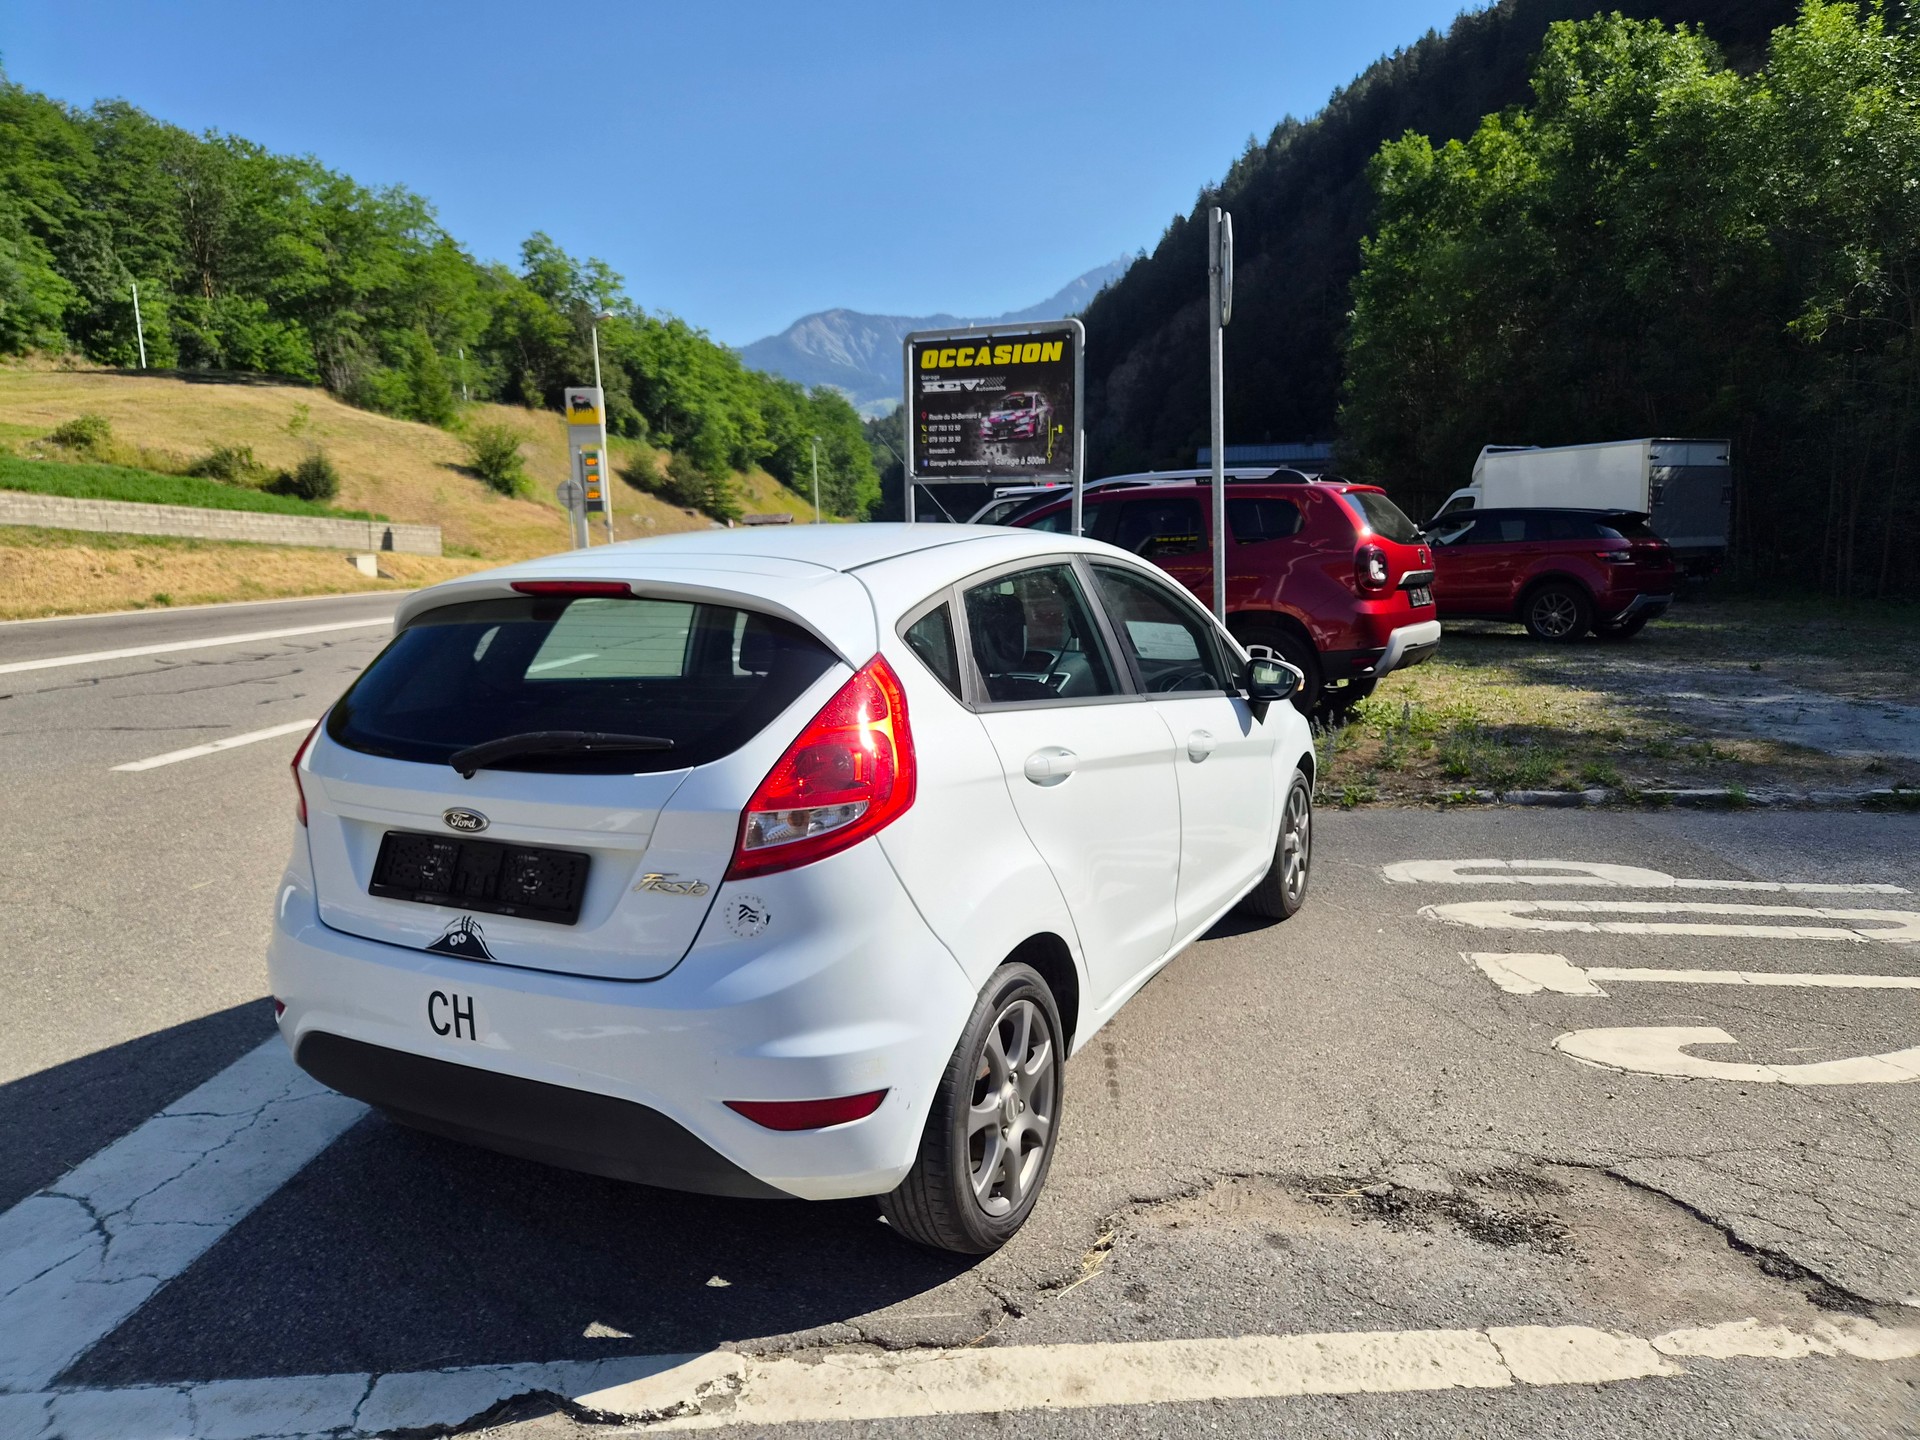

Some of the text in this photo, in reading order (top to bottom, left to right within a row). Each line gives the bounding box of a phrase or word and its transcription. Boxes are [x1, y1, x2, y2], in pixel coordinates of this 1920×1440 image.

[921, 341, 1063, 369] OCCASION
[929, 460, 947, 468] Garage
[995, 456, 1046, 467] Garage à 500m
[450, 812, 477, 829] Ford
[632, 872, 710, 897] Fiesta
[428, 990, 476, 1041] CH
